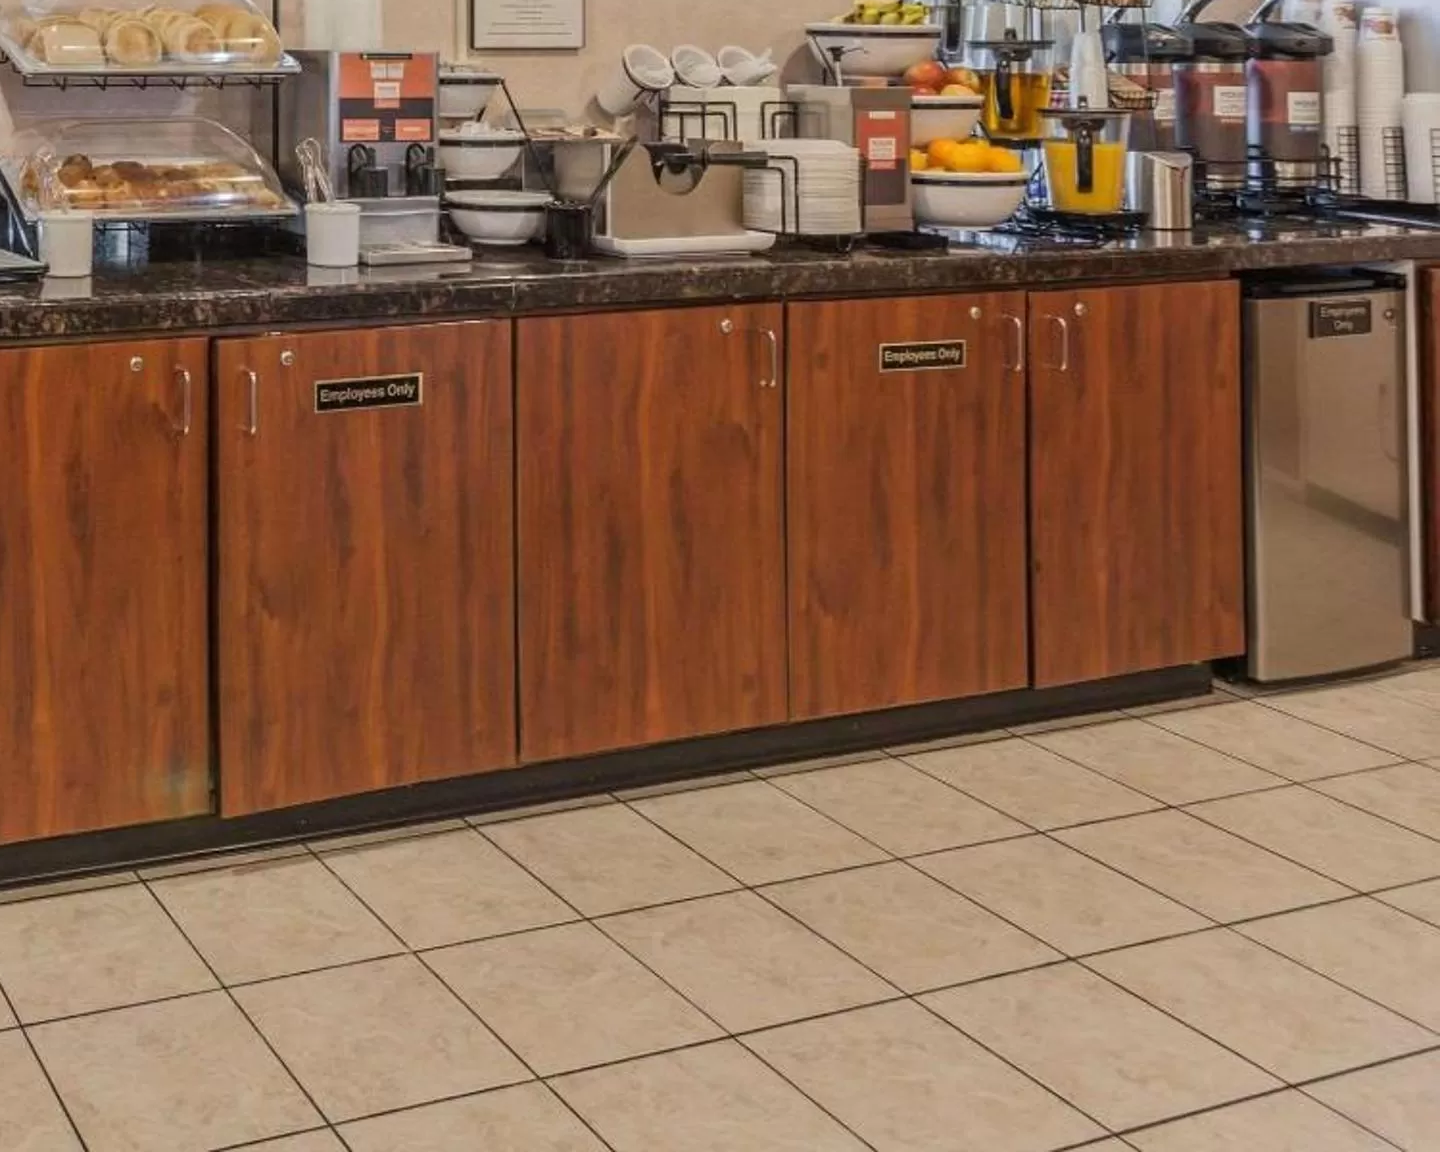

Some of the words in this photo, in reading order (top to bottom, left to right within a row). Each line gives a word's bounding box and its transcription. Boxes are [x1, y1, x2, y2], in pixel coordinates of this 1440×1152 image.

[884, 349, 937, 364] Employees
[938, 347, 960, 362] Only
[320, 388, 385, 403] Employees
[387, 383, 416, 398] Only
